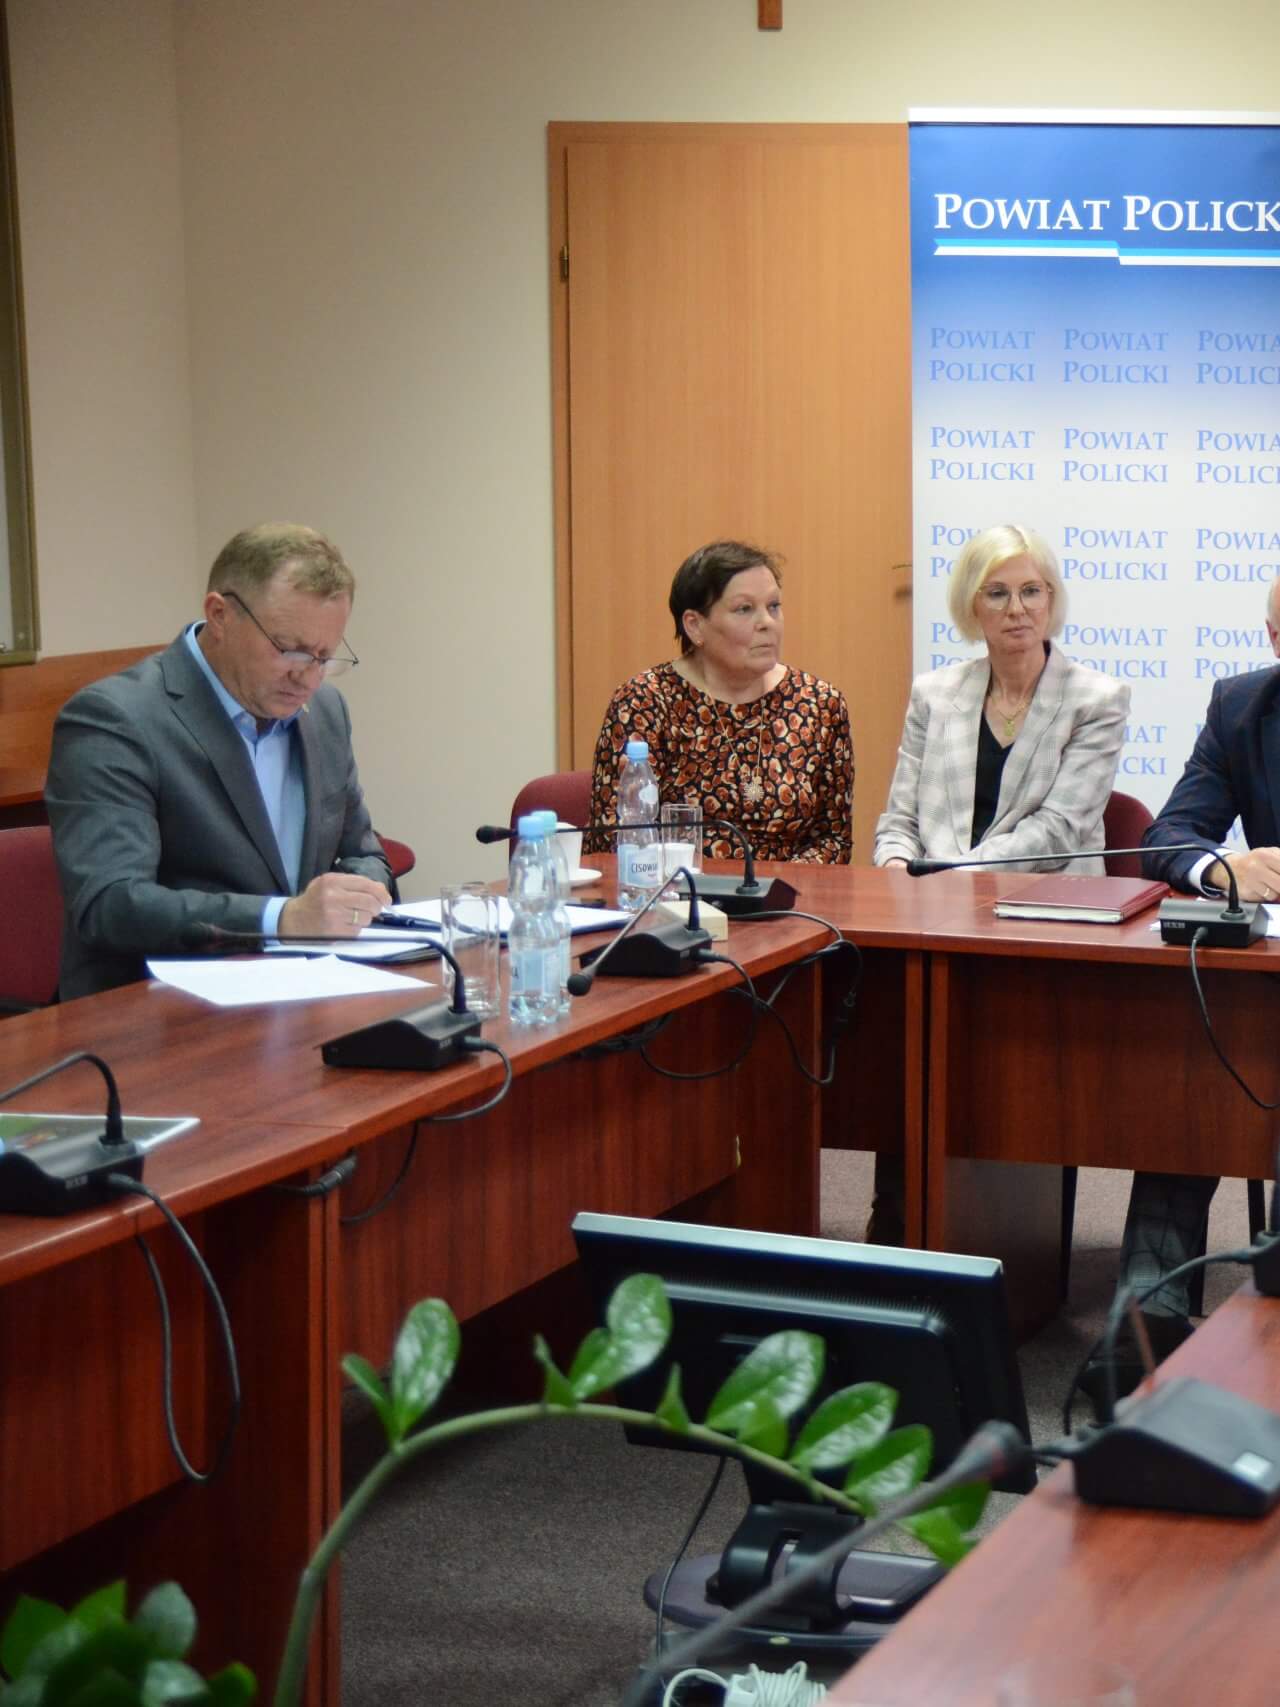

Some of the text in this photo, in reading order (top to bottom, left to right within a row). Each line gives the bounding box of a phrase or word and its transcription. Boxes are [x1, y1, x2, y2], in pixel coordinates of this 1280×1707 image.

[934, 193, 1110, 231] POWIAT
[929, 327, 1036, 350] POWIAT
[1063, 328, 1169, 352] POWIAT
[928, 359, 1036, 382] POLICKI
[1063, 360, 1169, 384] POLICKI
[930, 426, 1036, 450] POWIAT
[1063, 427, 1169, 451] POWIAT
[929, 458, 1036, 481] POLICKI
[1062, 460, 1169, 484] POLICKI
[1063, 527, 1169, 549] POWIAT
[1062, 558, 1168, 582] POLICKI
[1063, 624, 1168, 648] POWIAT
[1195, 626, 1270, 648] POWI
[1065, 656, 1168, 678] LICKI
